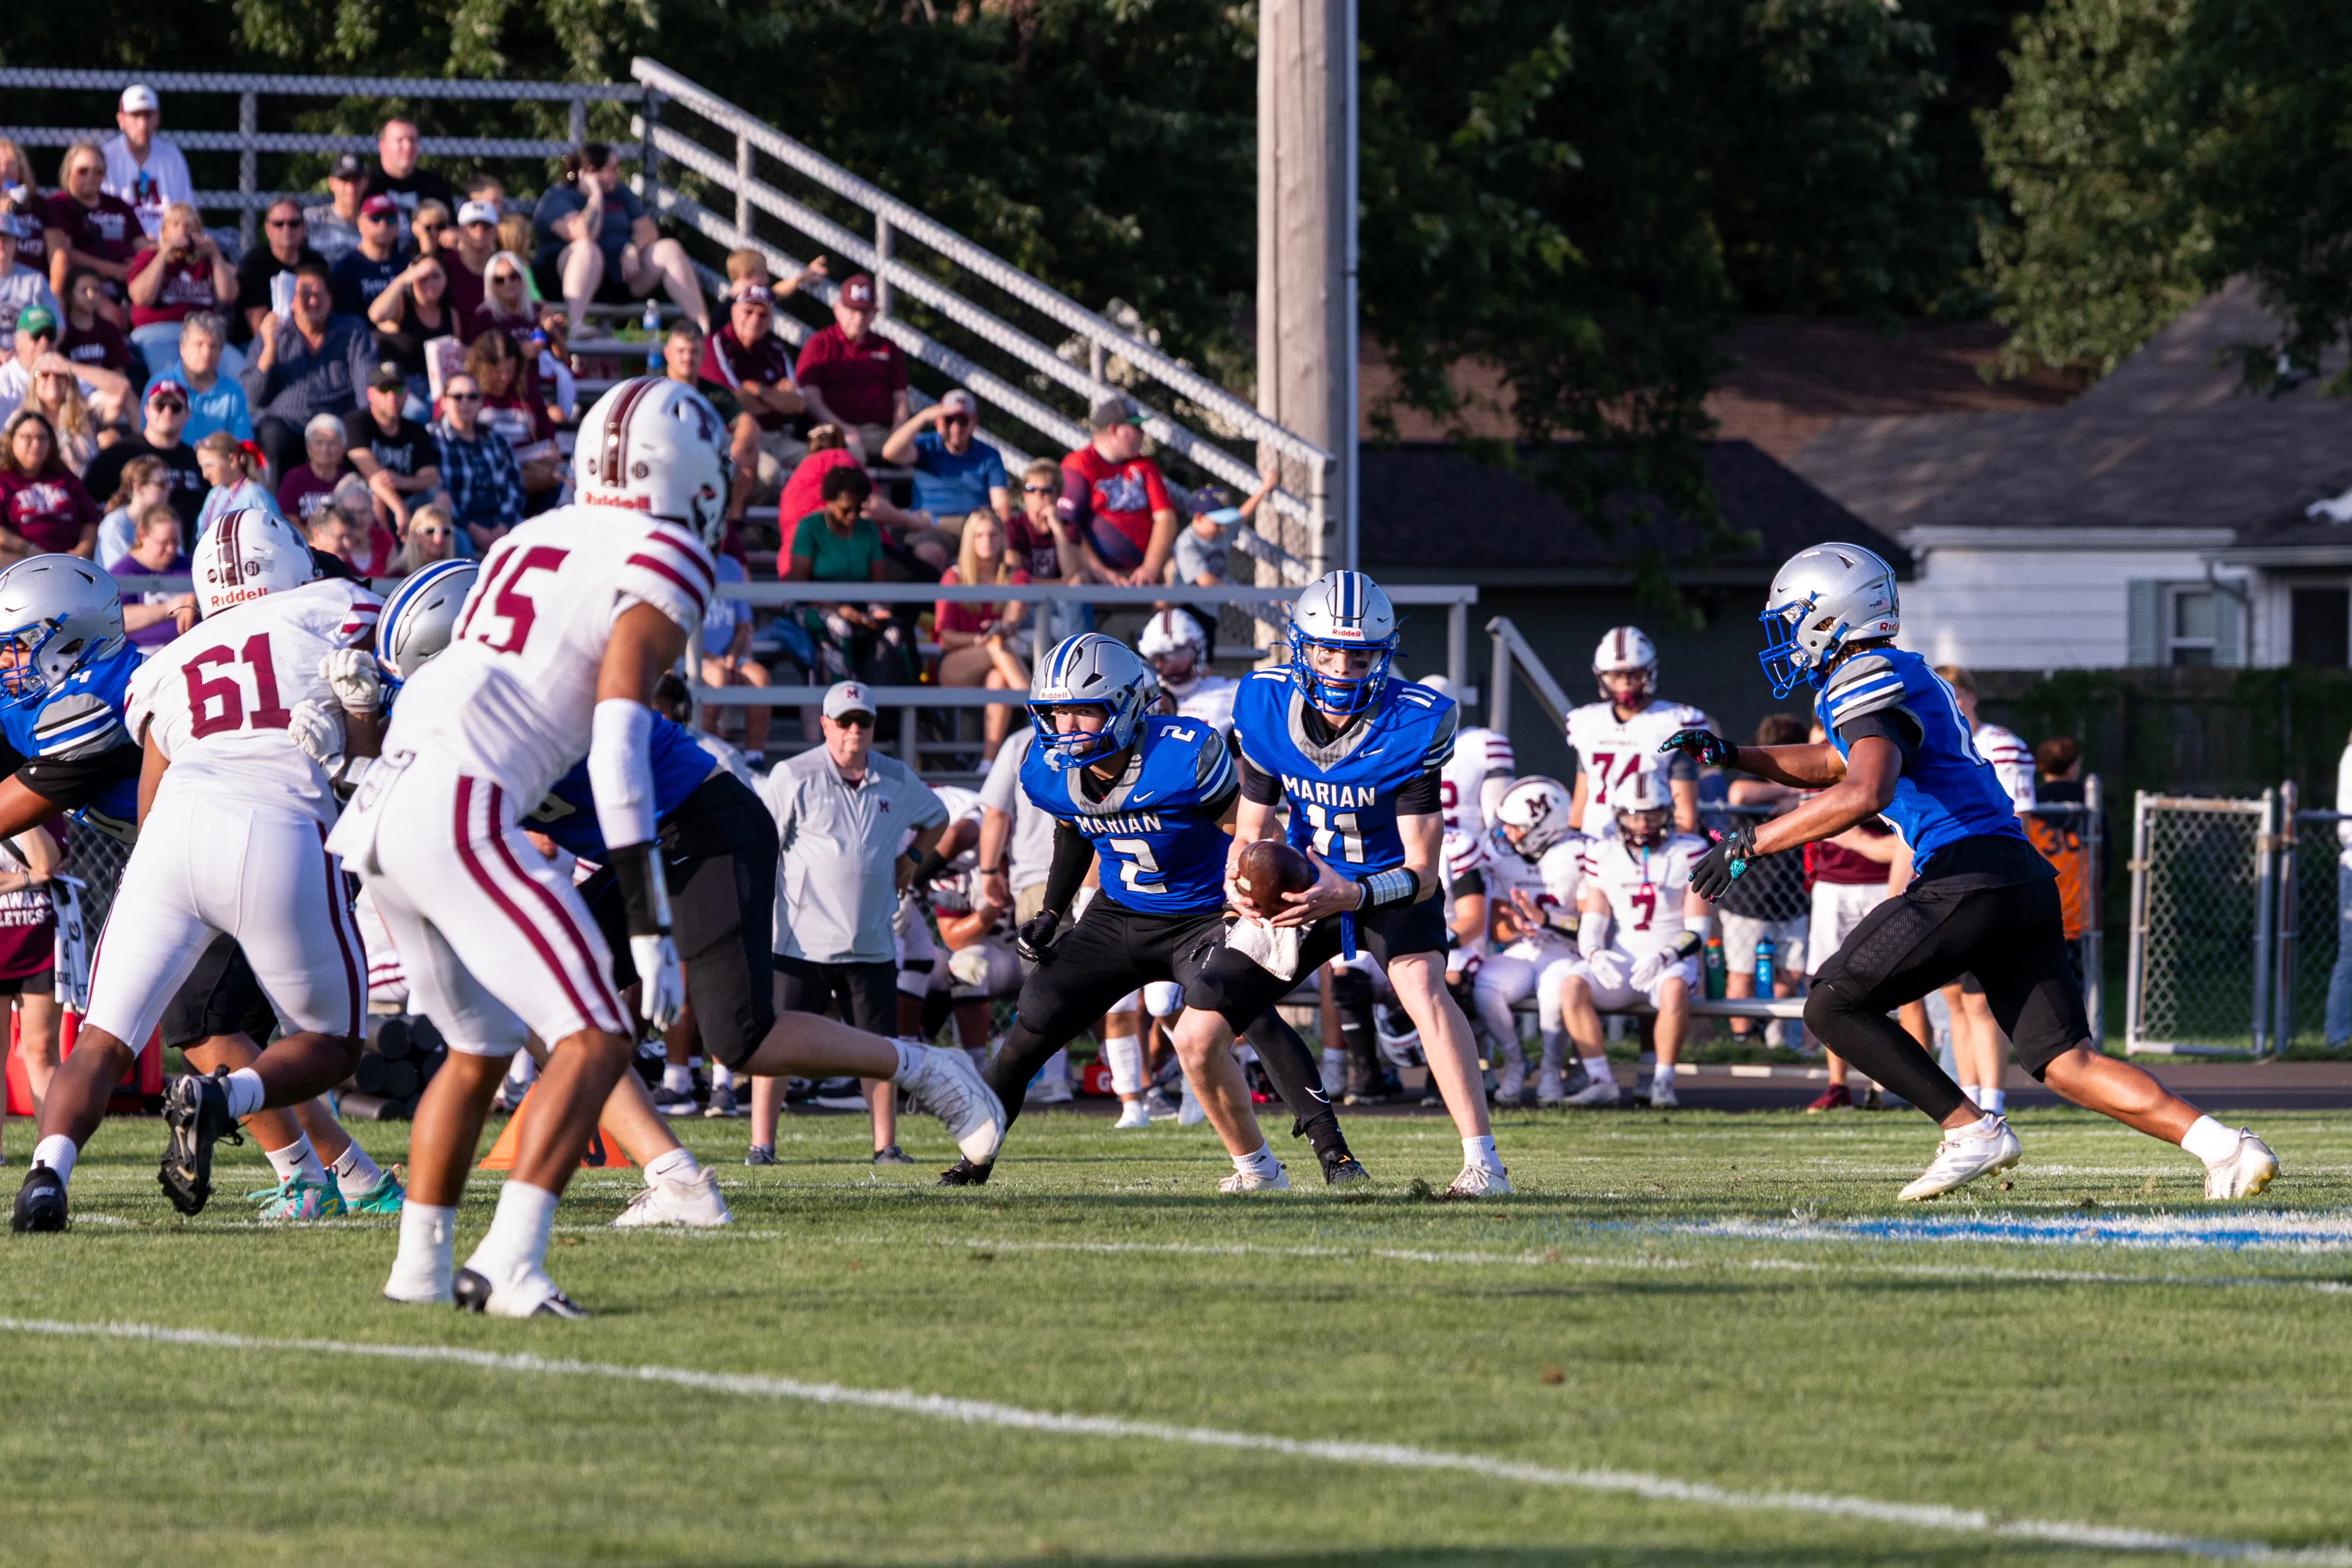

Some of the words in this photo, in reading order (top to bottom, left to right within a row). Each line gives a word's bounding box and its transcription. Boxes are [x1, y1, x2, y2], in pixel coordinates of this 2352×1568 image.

[211, 587, 267, 608] Riddell
[458, 545, 571, 656] 15
[1332, 629, 1361, 637] Riddell
[181, 632, 291, 740] 61
[846, 689, 858, 700] M
[1159, 725, 1196, 742] 2
[1281, 773, 1375, 808] MARIAN
[879, 800, 889, 813] M
[1526, 793, 1552, 818] M
[1074, 811, 1162, 834] MARIAN
[1306, 803, 1364, 864] 11
[1109, 838, 1168, 893] 2
[1631, 894, 1657, 932] 7
[31, 1186, 56, 1199] NIKE
